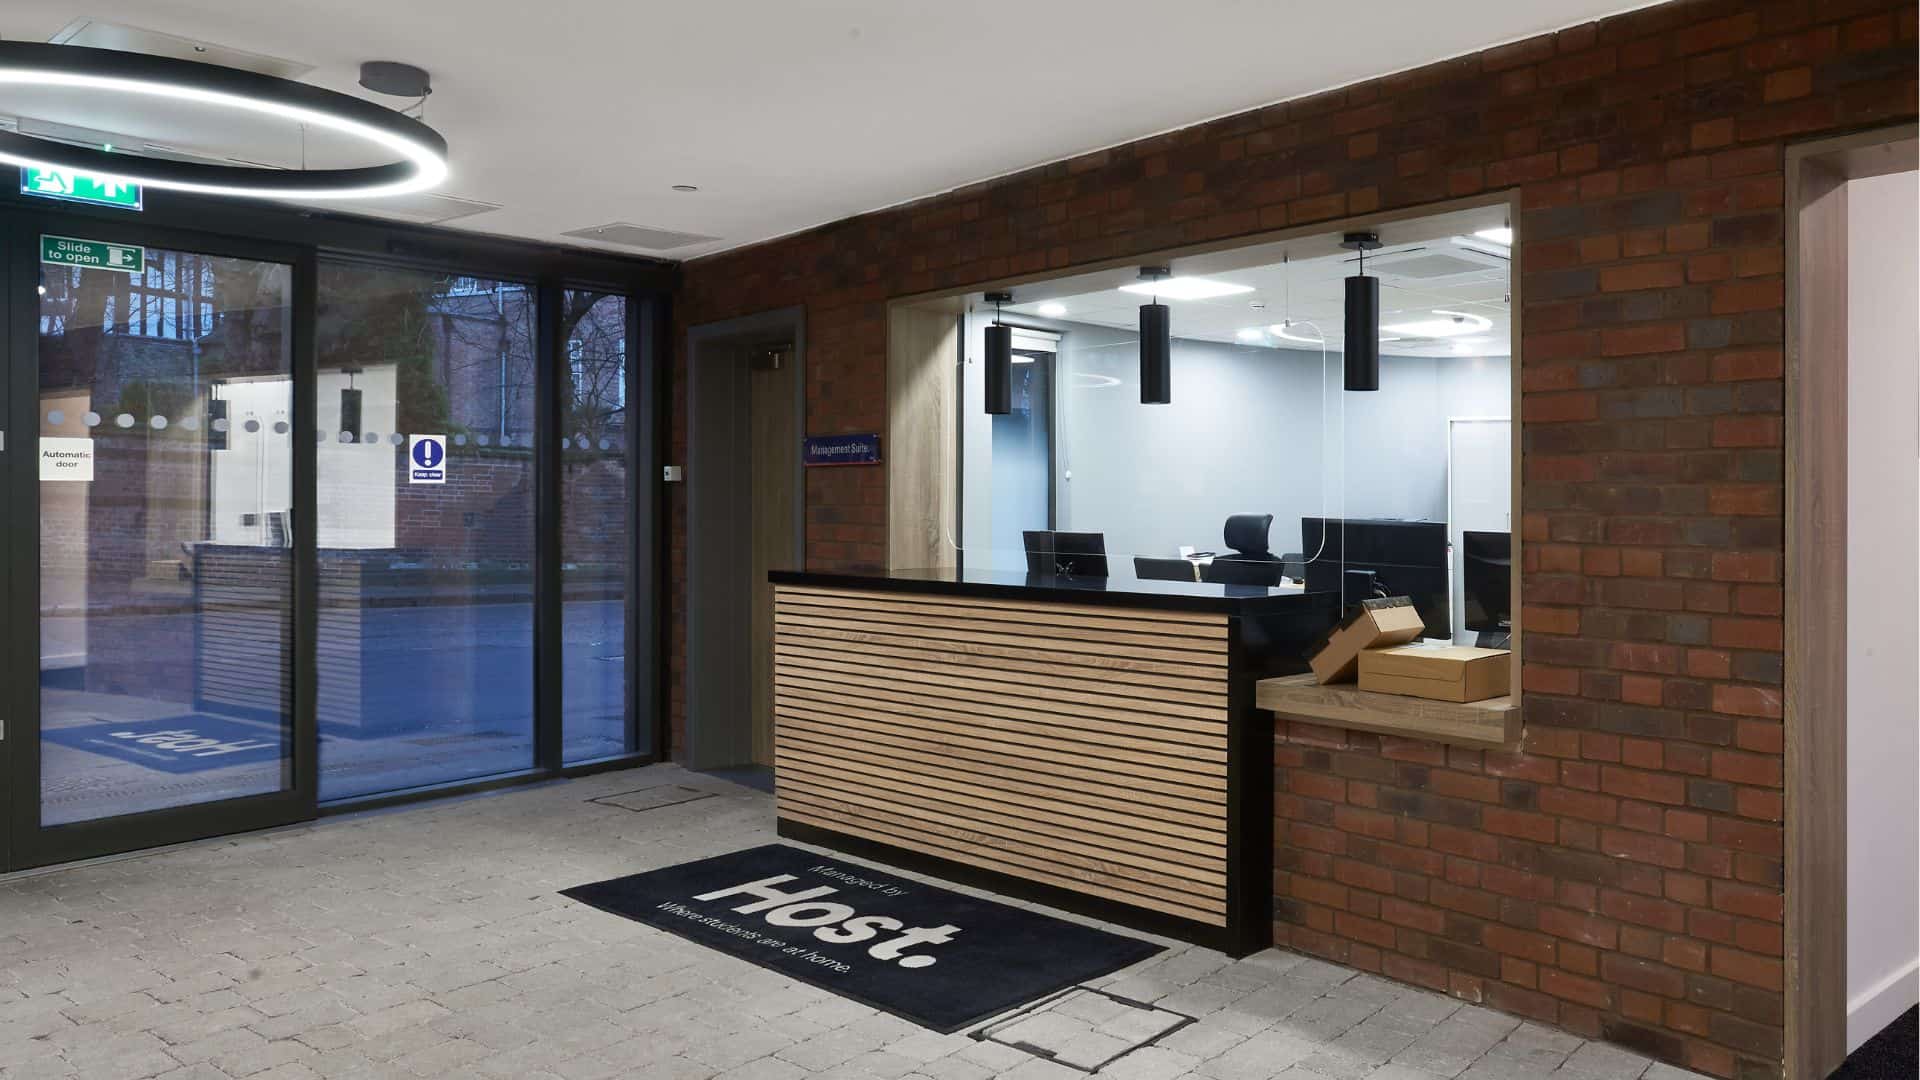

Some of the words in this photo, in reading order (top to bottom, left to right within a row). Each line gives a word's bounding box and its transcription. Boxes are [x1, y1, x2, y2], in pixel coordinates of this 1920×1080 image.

[57, 241, 92, 254] Slide
[48, 250, 62, 259] to
[66, 253, 100, 264] open
[43, 450, 91, 459] Automatic
[811, 444, 850, 457] Management
[55, 460, 79, 468] door
[807, 865, 889, 890] Managed
[881, 886, 911, 897] by
[692, 873, 962, 969] Host.
[655, 901, 703, 920] Where
[698, 917, 762, 940] students
[756, 938, 787, 948] are
[782, 945, 807, 956] at
